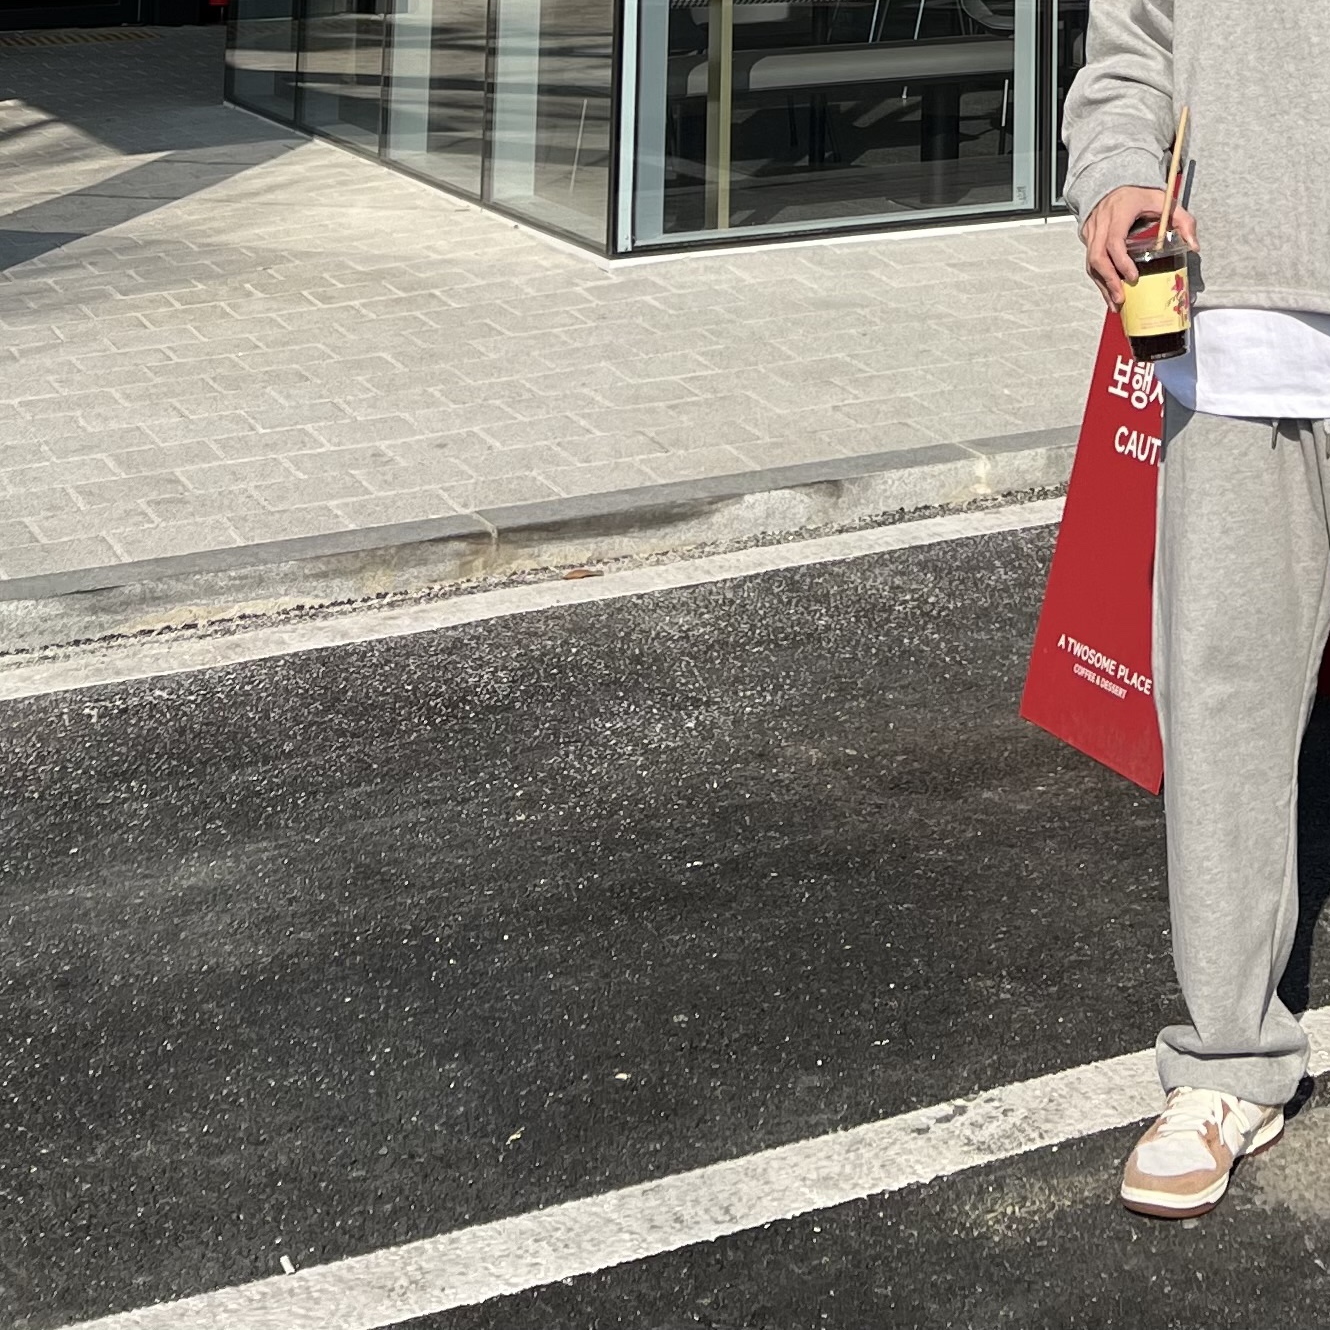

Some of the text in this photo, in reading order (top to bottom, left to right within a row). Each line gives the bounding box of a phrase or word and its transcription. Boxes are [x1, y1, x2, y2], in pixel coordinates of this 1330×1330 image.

[1114, 425, 1162, 467] CAUT
[1057, 633, 1153, 695] A TWOSOME PLACE
[1073, 663, 1097, 684] COFFEE
[1100, 677, 1128, 700] DESSERT
